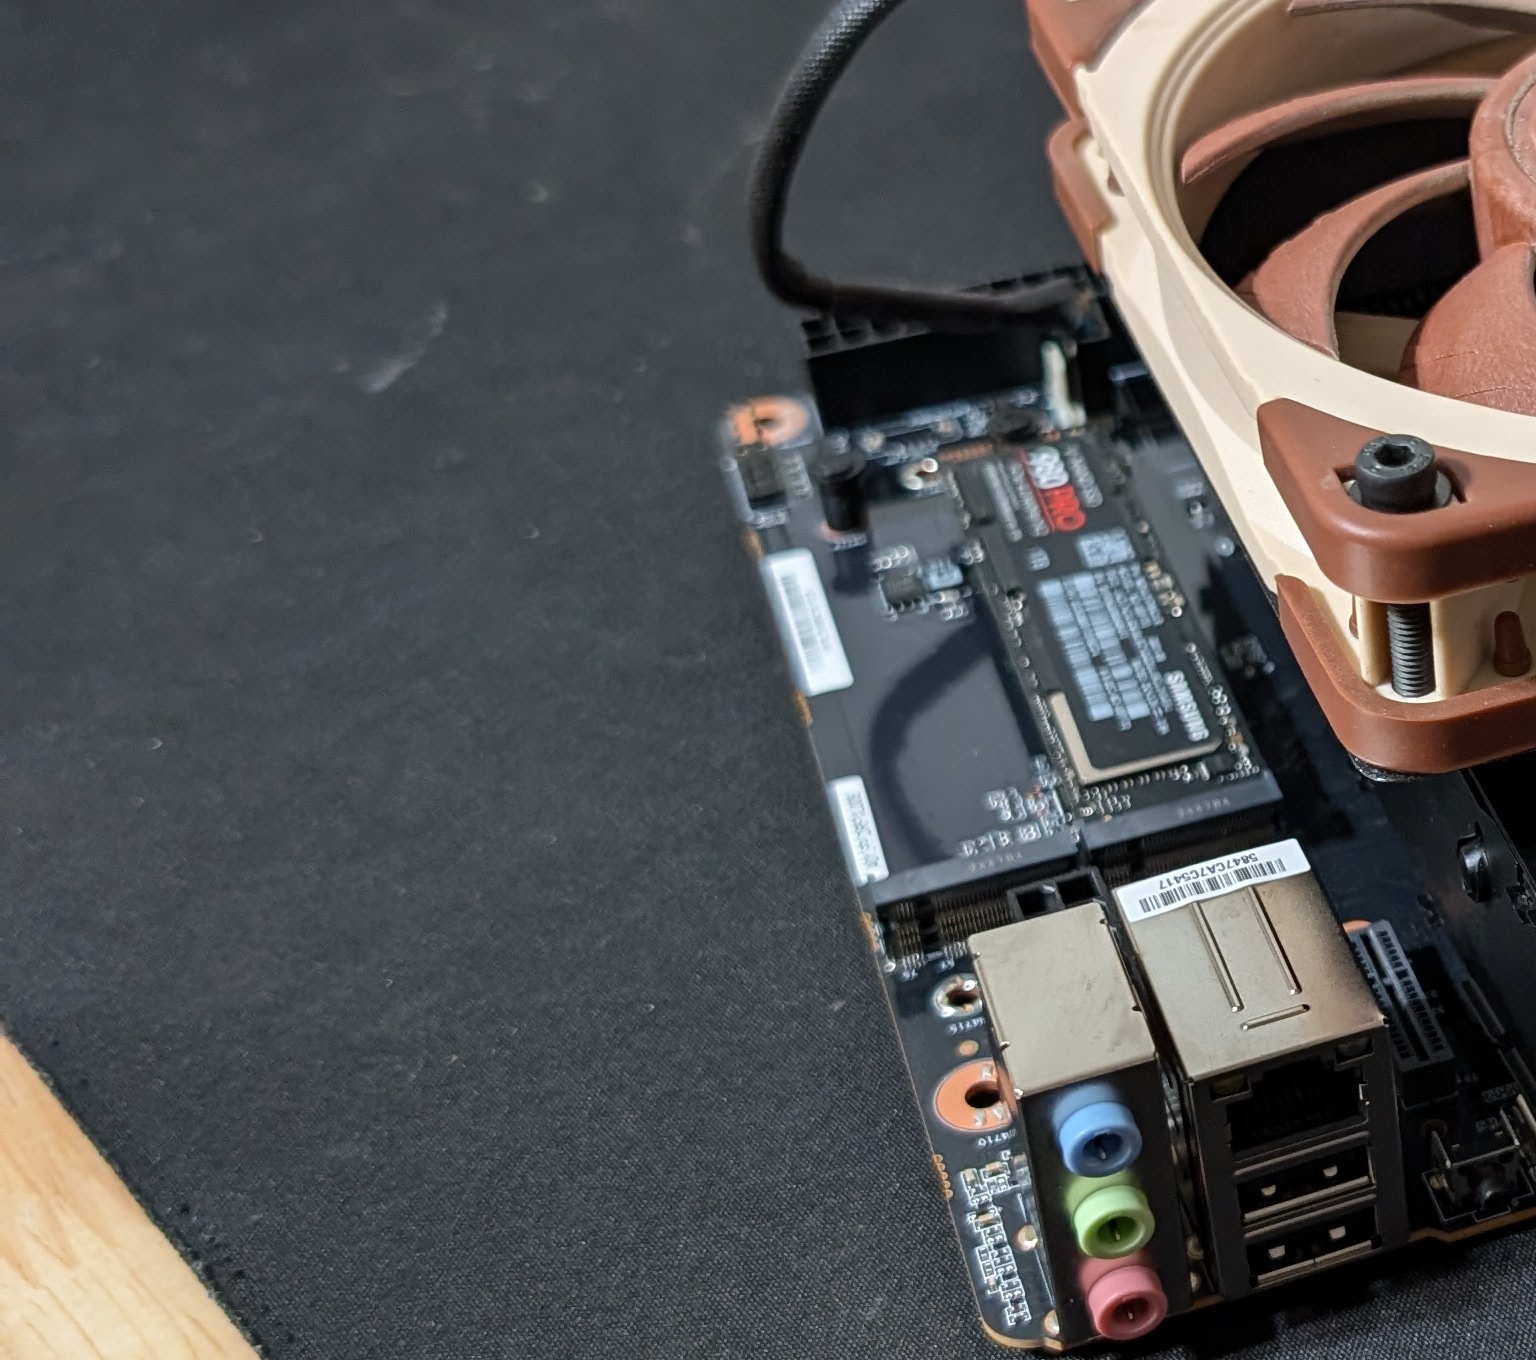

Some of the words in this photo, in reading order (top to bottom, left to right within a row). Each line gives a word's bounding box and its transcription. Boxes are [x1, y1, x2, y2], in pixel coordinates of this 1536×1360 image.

[1041, 484, 1087, 532] PRO
[1164, 668, 1211, 742] SAMSUNG
[1159, 852, 1259, 890] 5847CA7C5417
